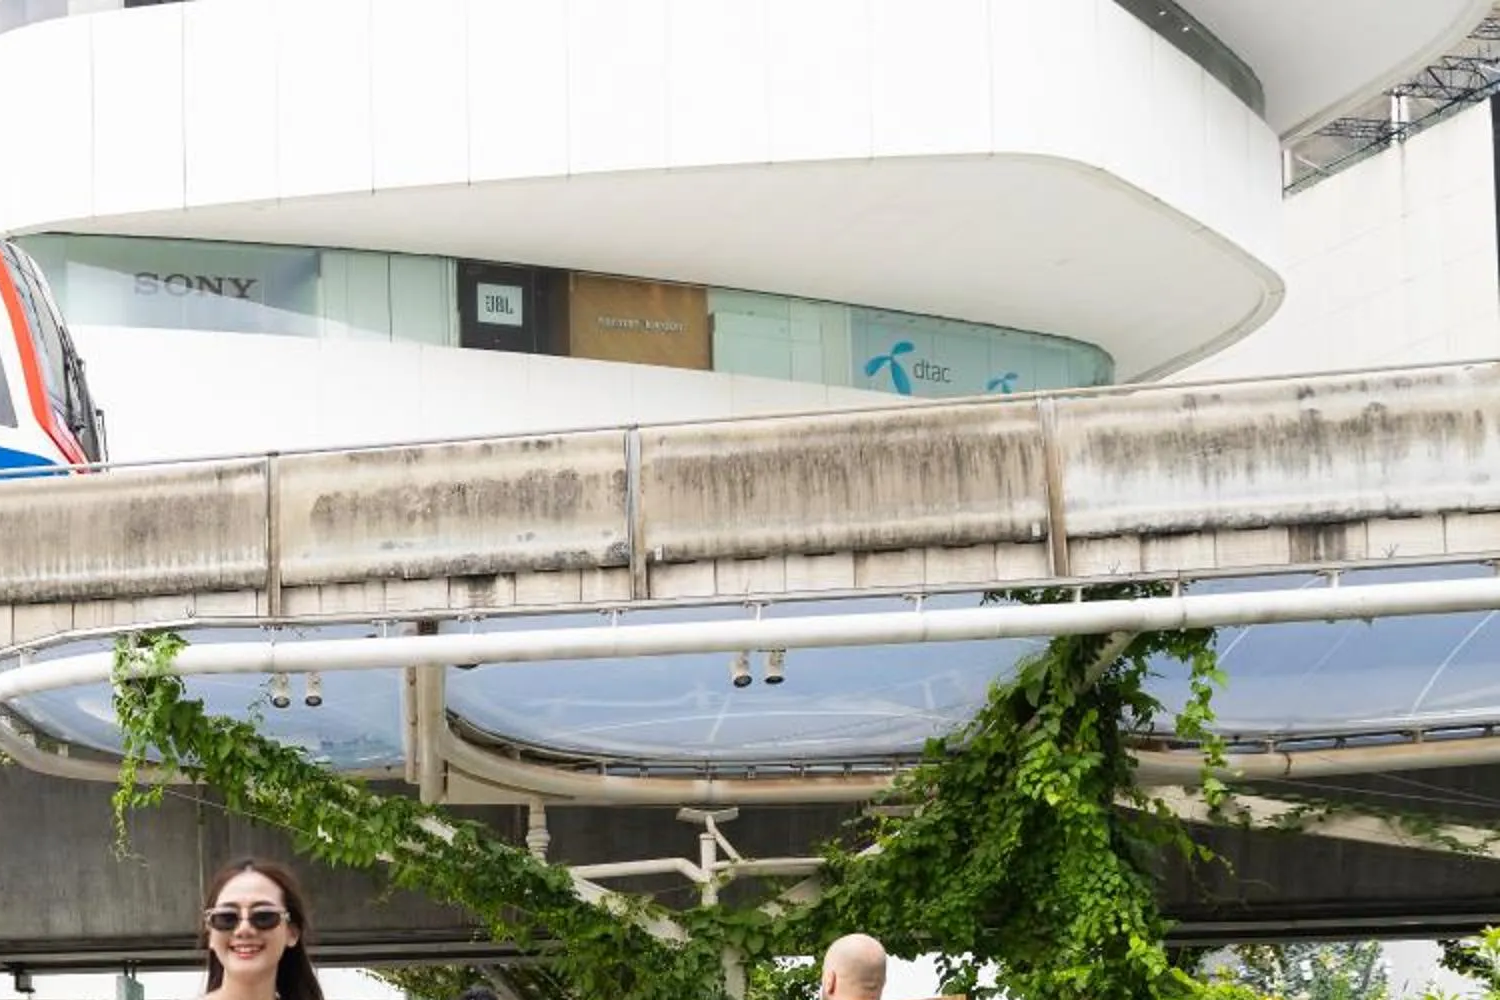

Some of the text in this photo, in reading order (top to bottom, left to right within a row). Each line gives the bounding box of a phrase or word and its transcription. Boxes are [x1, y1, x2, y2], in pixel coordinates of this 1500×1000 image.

[134, 272, 258, 299] SONY
[484, 294, 515, 315] JBL
[912, 359, 952, 383] dtac
